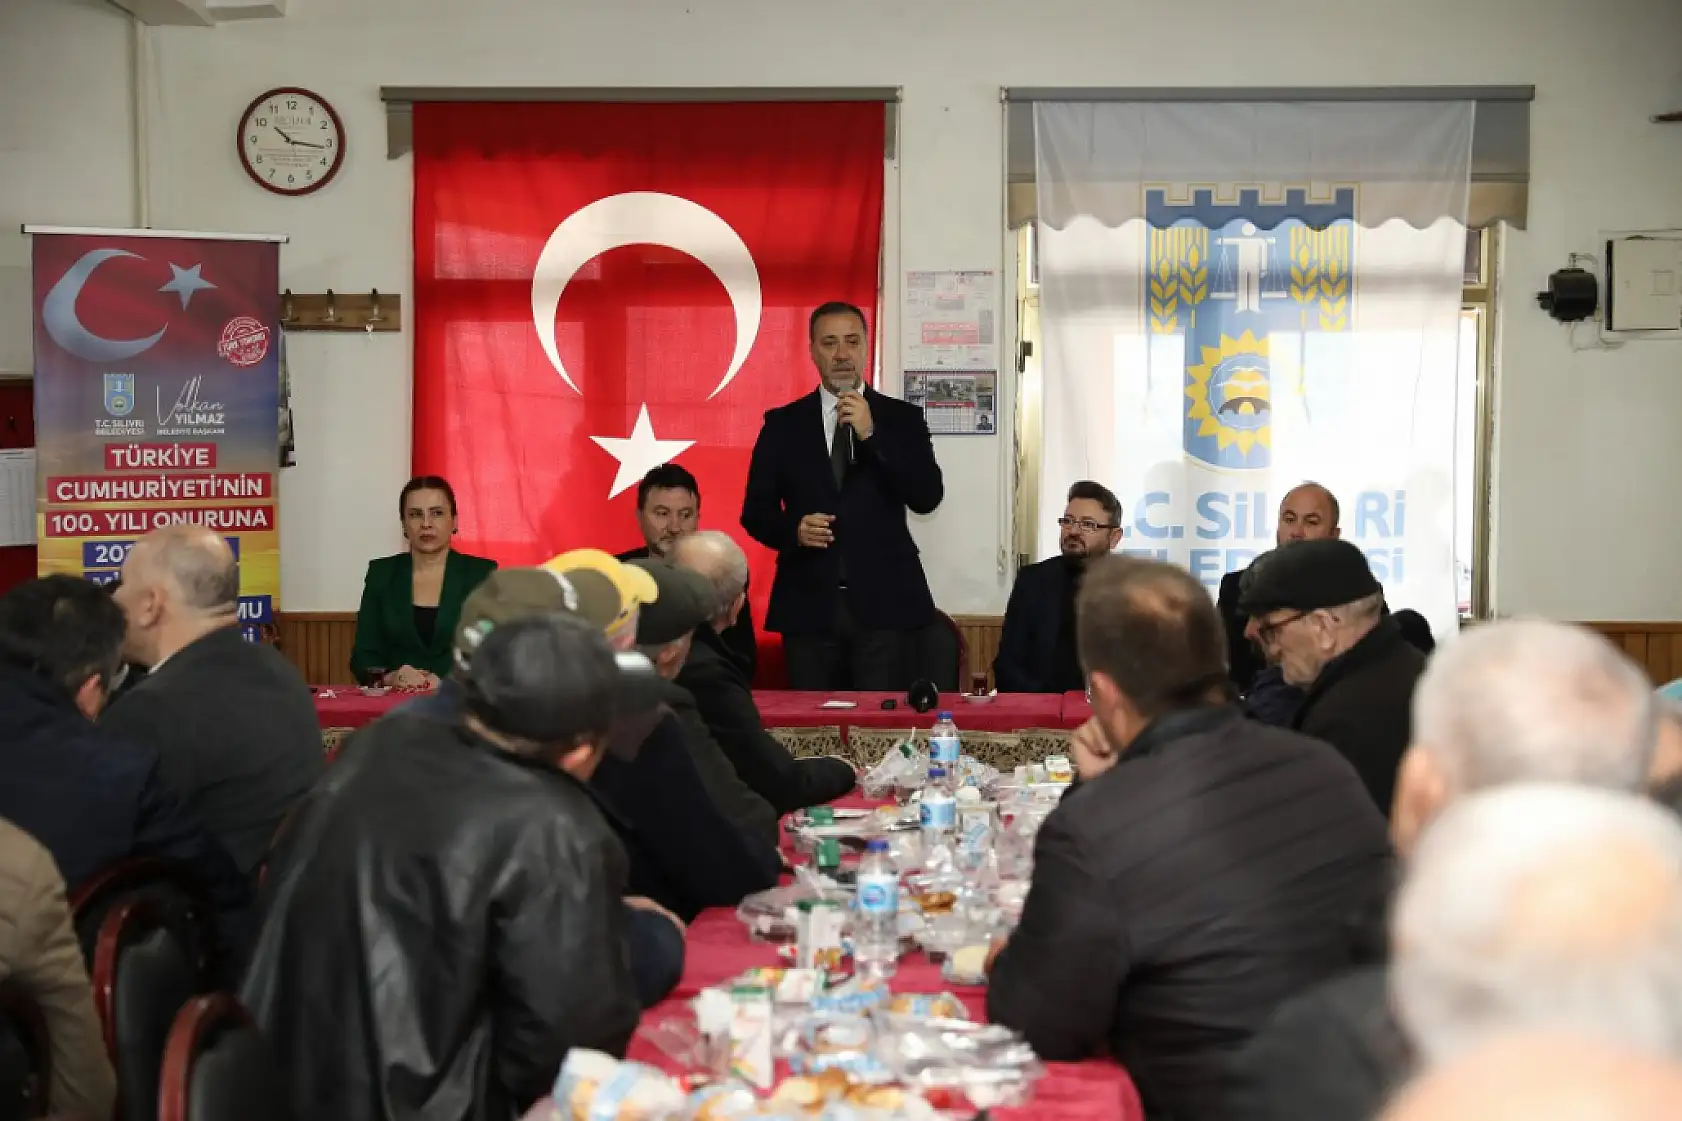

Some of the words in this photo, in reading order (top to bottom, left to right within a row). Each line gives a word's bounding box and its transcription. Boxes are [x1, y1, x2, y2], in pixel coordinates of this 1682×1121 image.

[269, 104, 278, 114] 11
[286, 100, 297, 110] 12
[255, 118, 267, 126] 10
[320, 120, 328, 130] 2
[250, 135, 257, 145] 9
[326, 138, 333, 148] 3
[319, 157, 327, 166] 4
[287, 174, 295, 184] 6
[174, 413, 225, 425] YILMAZ
[111, 443, 210, 468] TÜRKİYE
[56, 473, 263, 501] CUMHURİYETİ'NİN
[51, 513, 100, 533] 100.
[105, 511, 148, 531] YILI
[152, 509, 268, 530] ONURUNA
